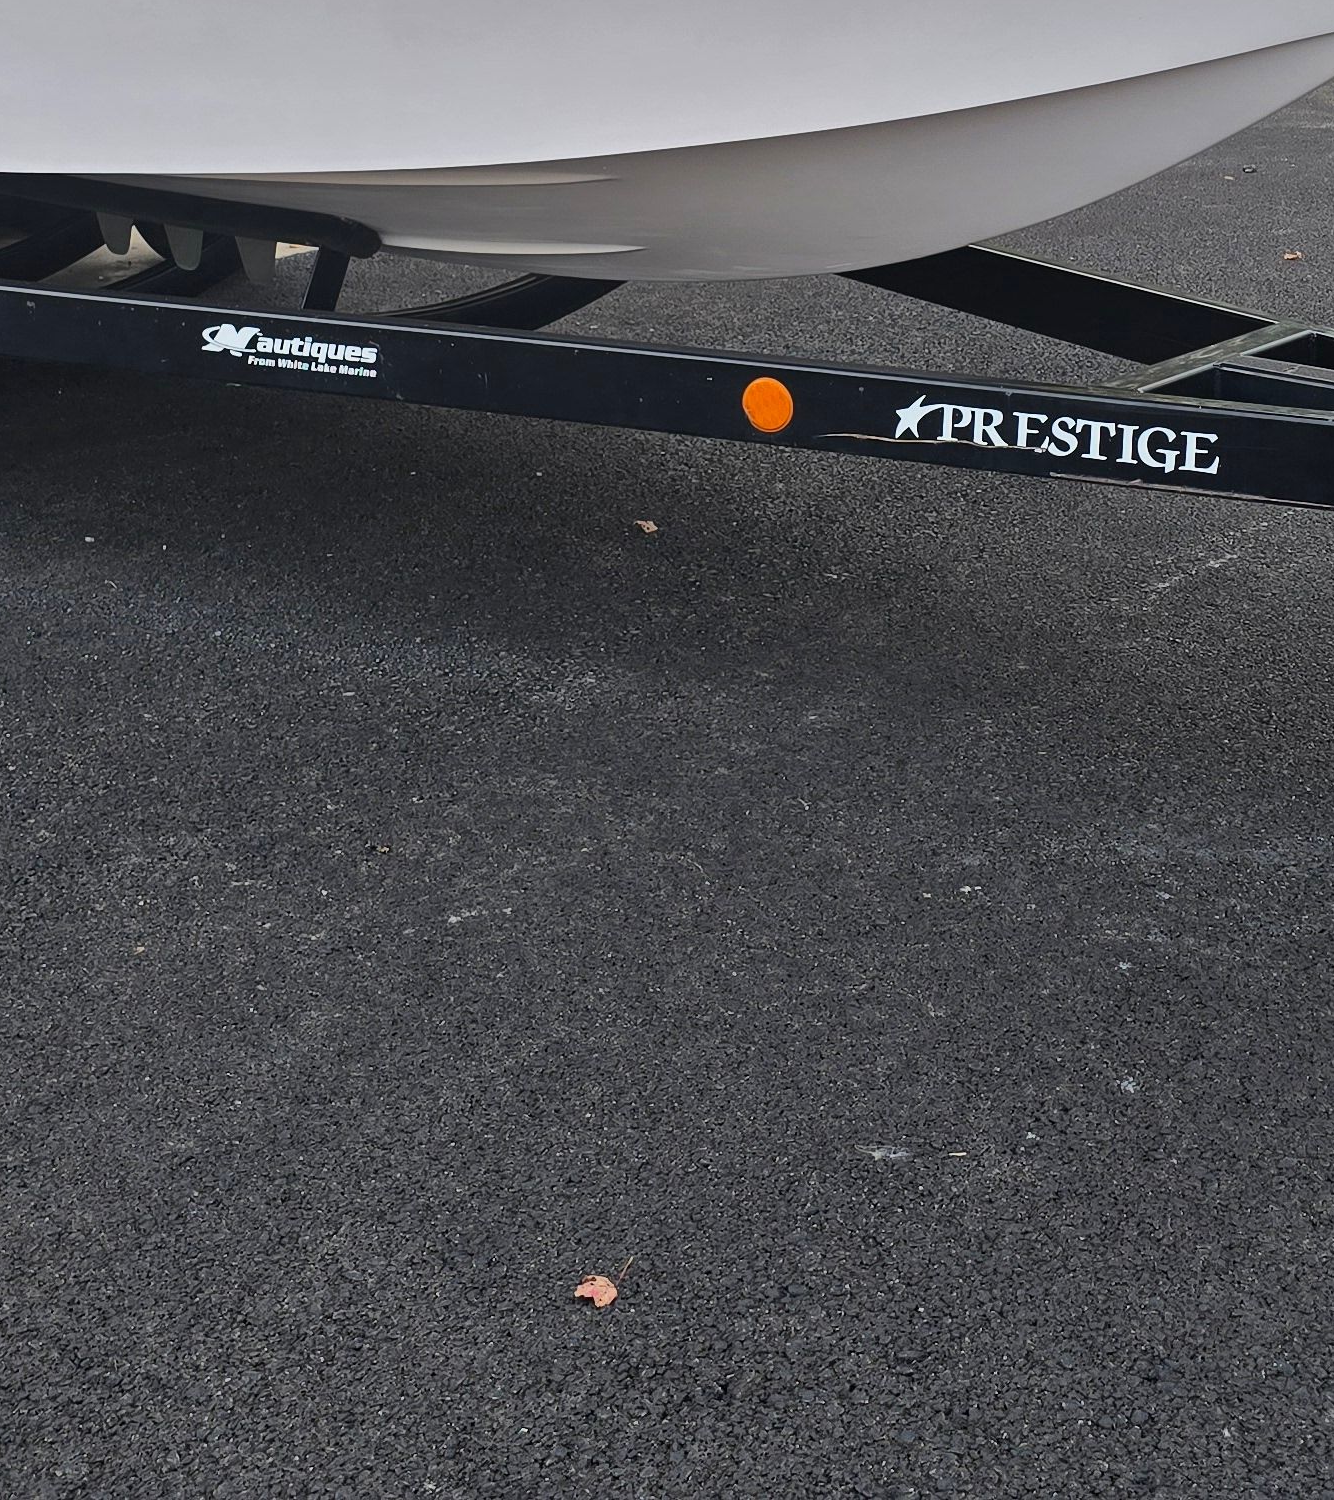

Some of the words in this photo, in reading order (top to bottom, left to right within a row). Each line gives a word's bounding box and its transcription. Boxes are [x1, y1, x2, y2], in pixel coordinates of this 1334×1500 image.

[202, 324, 378, 364] Nautiques
[247, 355, 276, 367] From
[278, 358, 309, 371] White
[311, 362, 337, 373] Lake
[338, 364, 378, 378] Marine
[935, 403, 1220, 475] PRESTIGE
